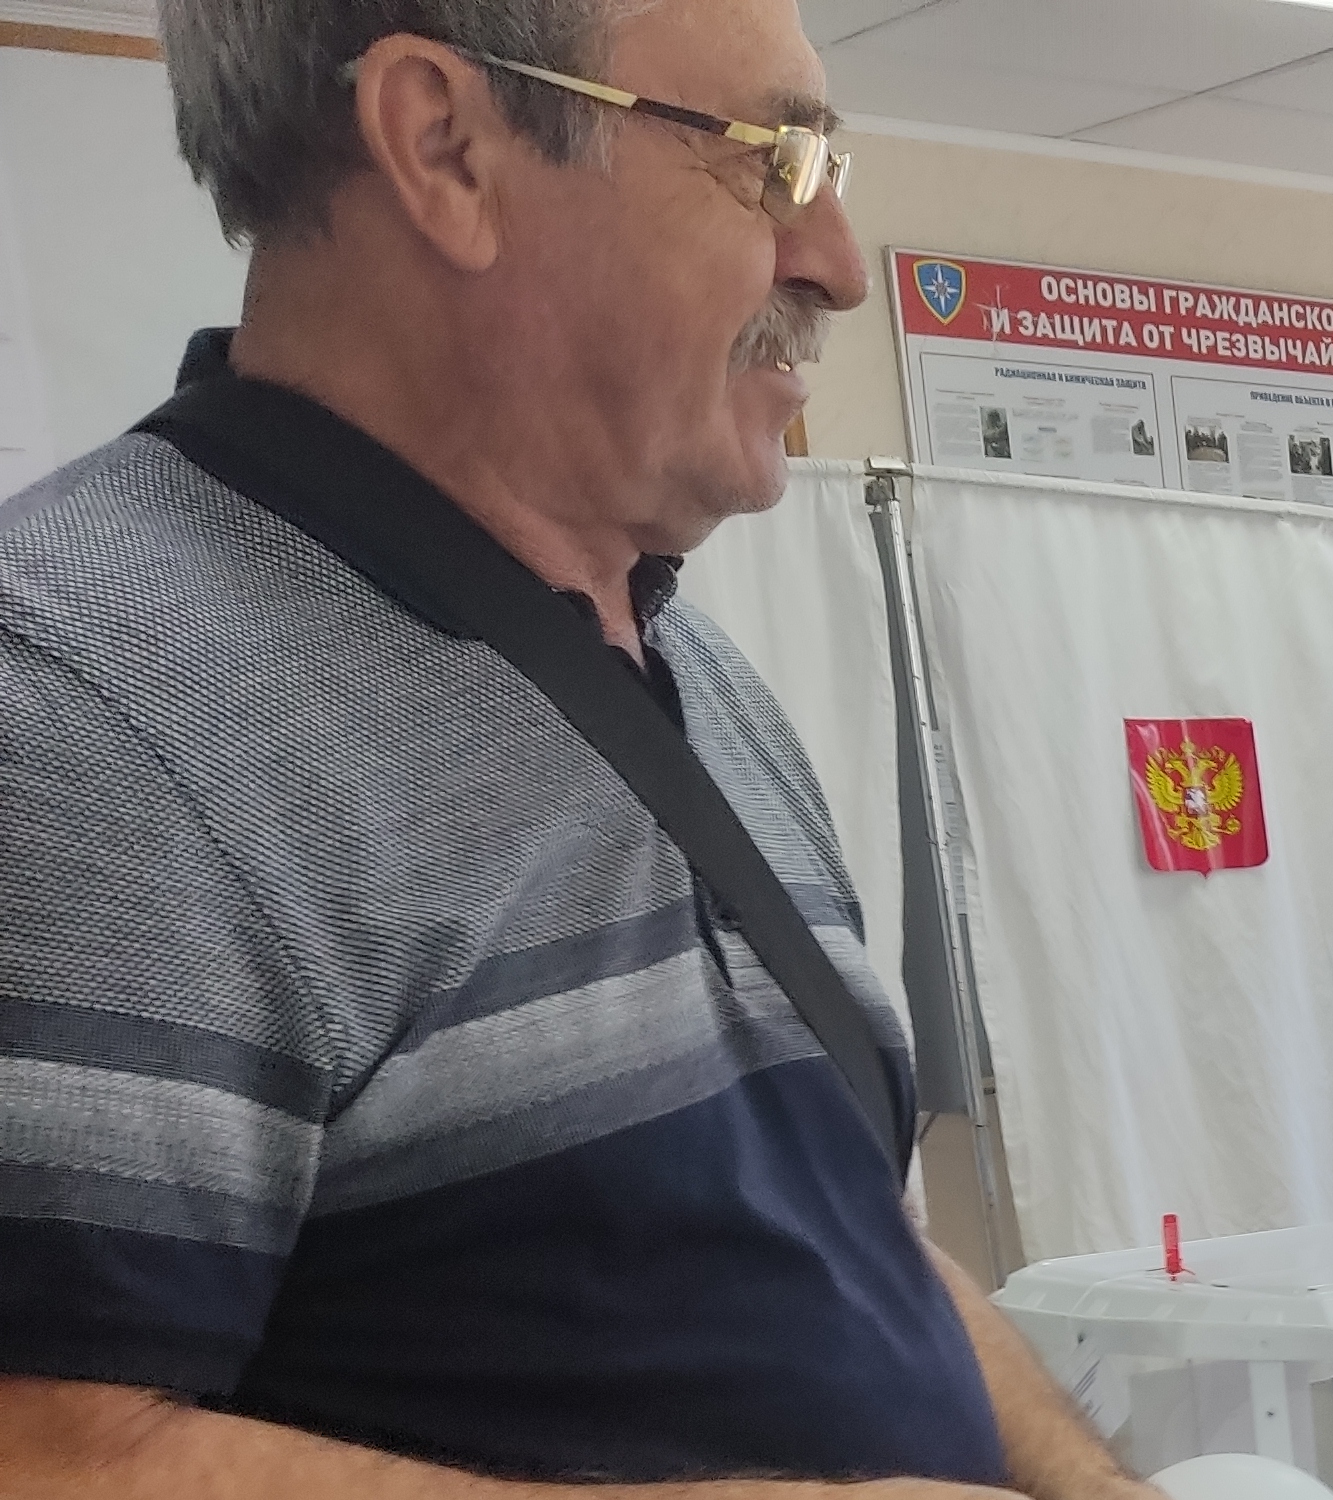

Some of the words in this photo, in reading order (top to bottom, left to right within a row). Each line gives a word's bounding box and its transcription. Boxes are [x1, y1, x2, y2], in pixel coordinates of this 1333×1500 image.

[1040, 275, 1156, 314] ОСНОВЫ
[990, 307, 1012, 335] И
[1017, 310, 1138, 347] ЗАЩИТА
[1142, 324, 1175, 351] ОТ
